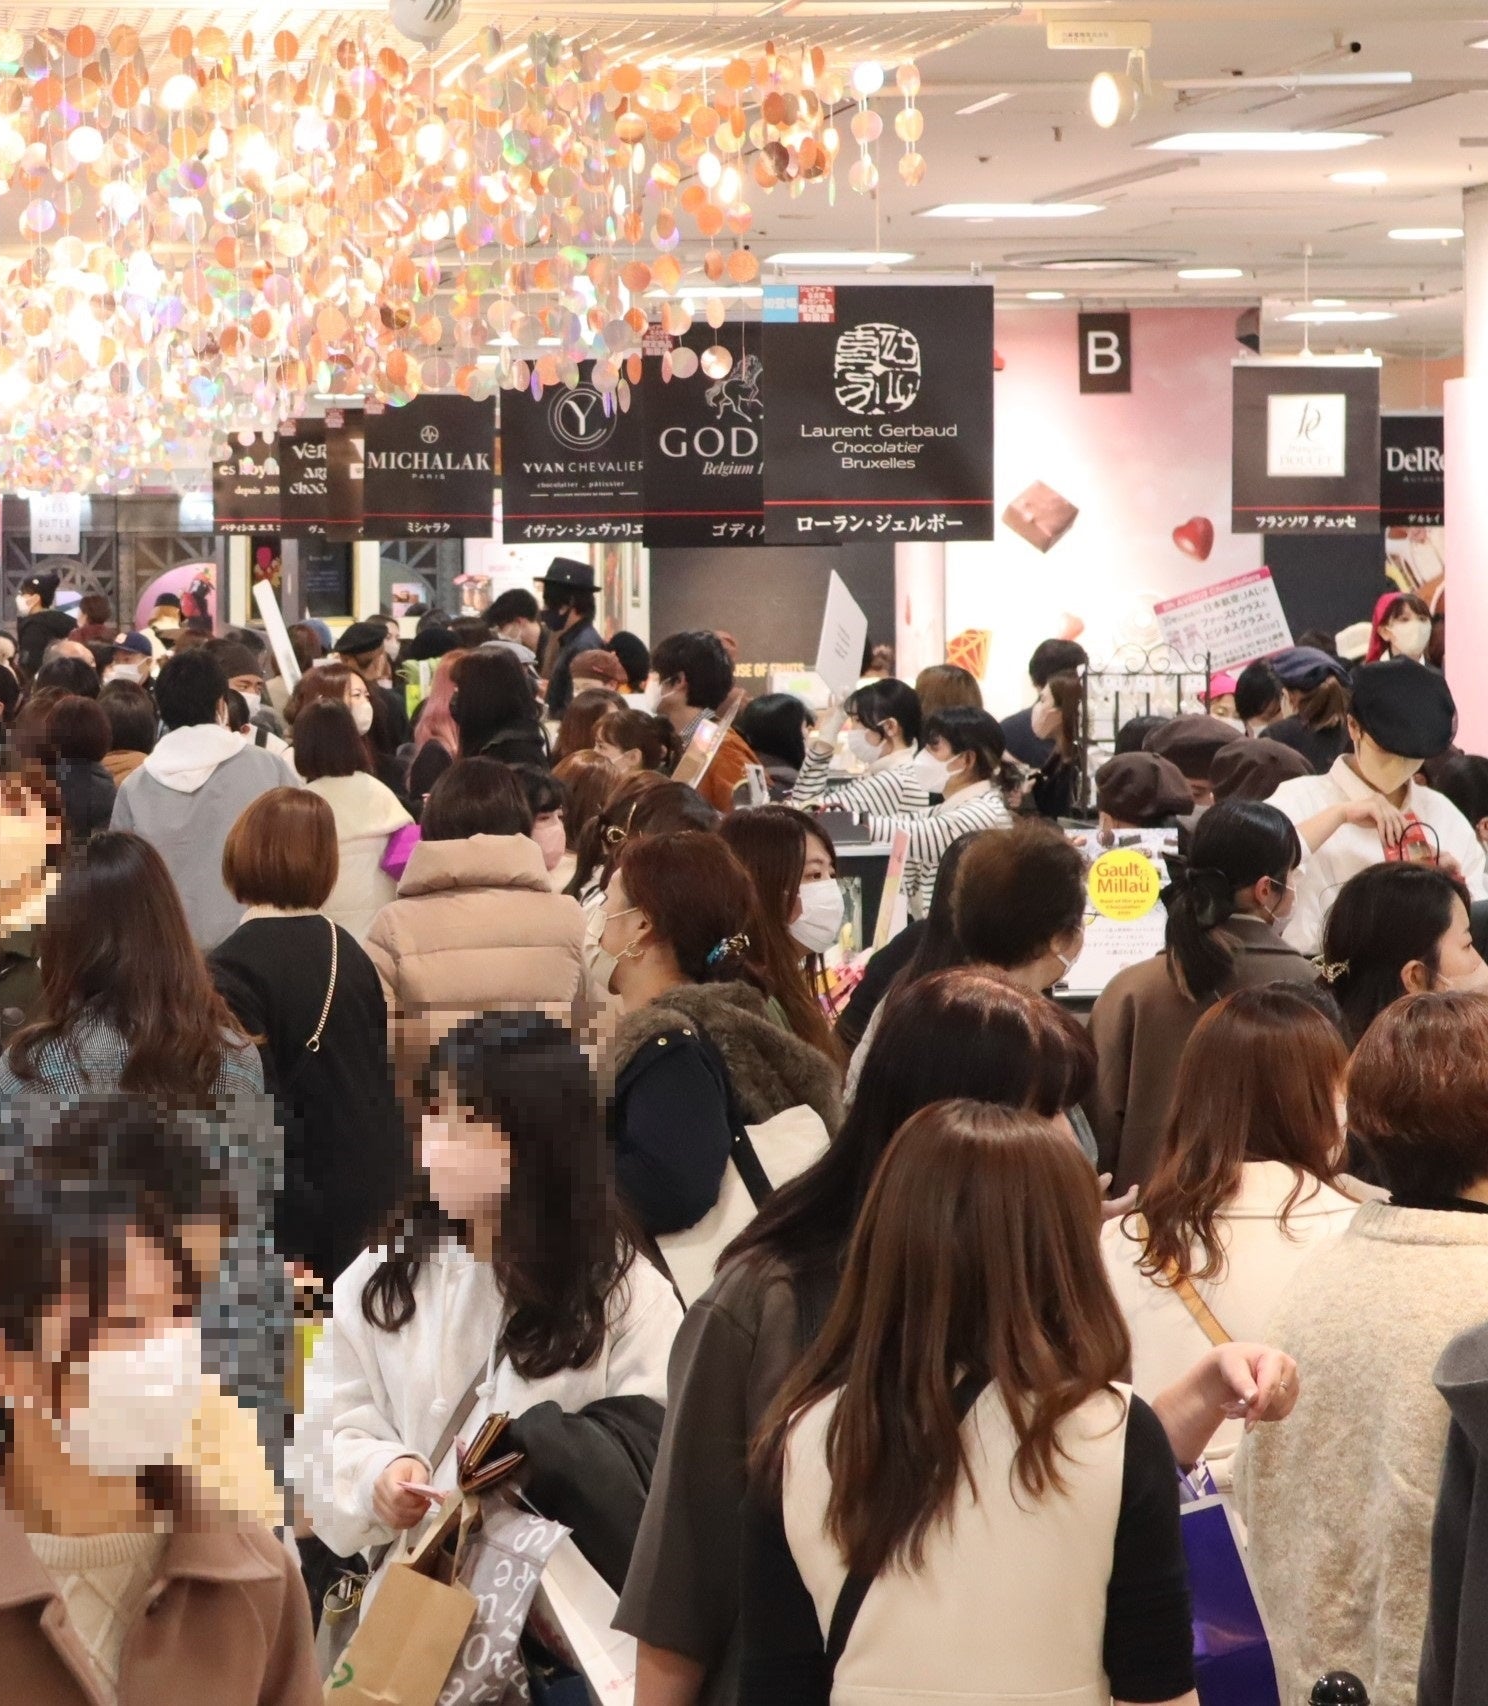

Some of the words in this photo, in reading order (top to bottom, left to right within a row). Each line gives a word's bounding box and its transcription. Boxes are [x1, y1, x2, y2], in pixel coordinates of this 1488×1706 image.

[1088, 331, 1122, 374] B
[801, 424, 872, 438] Laurent
[879, 424, 958, 438] Gerbaud
[660, 427, 758, 457] GOD
[832, 441, 924, 454] Chocolatier
[367, 451, 491, 470] MICHALAK
[842, 457, 916, 469] Bruxelles
[523, 463, 564, 473] YVAN
[702, 461, 755, 477] Belgium
[234, 486, 261, 497] depuis
[264, 485, 280, 495] 200
[407, 522, 450, 533] ミシャラク
[797, 513, 964, 533] ローラン・ジェルボー
[1256, 516, 1309, 528] フランソワ
[712, 522, 764, 538] ゴディ
[1096, 862, 1141, 877] Gault
